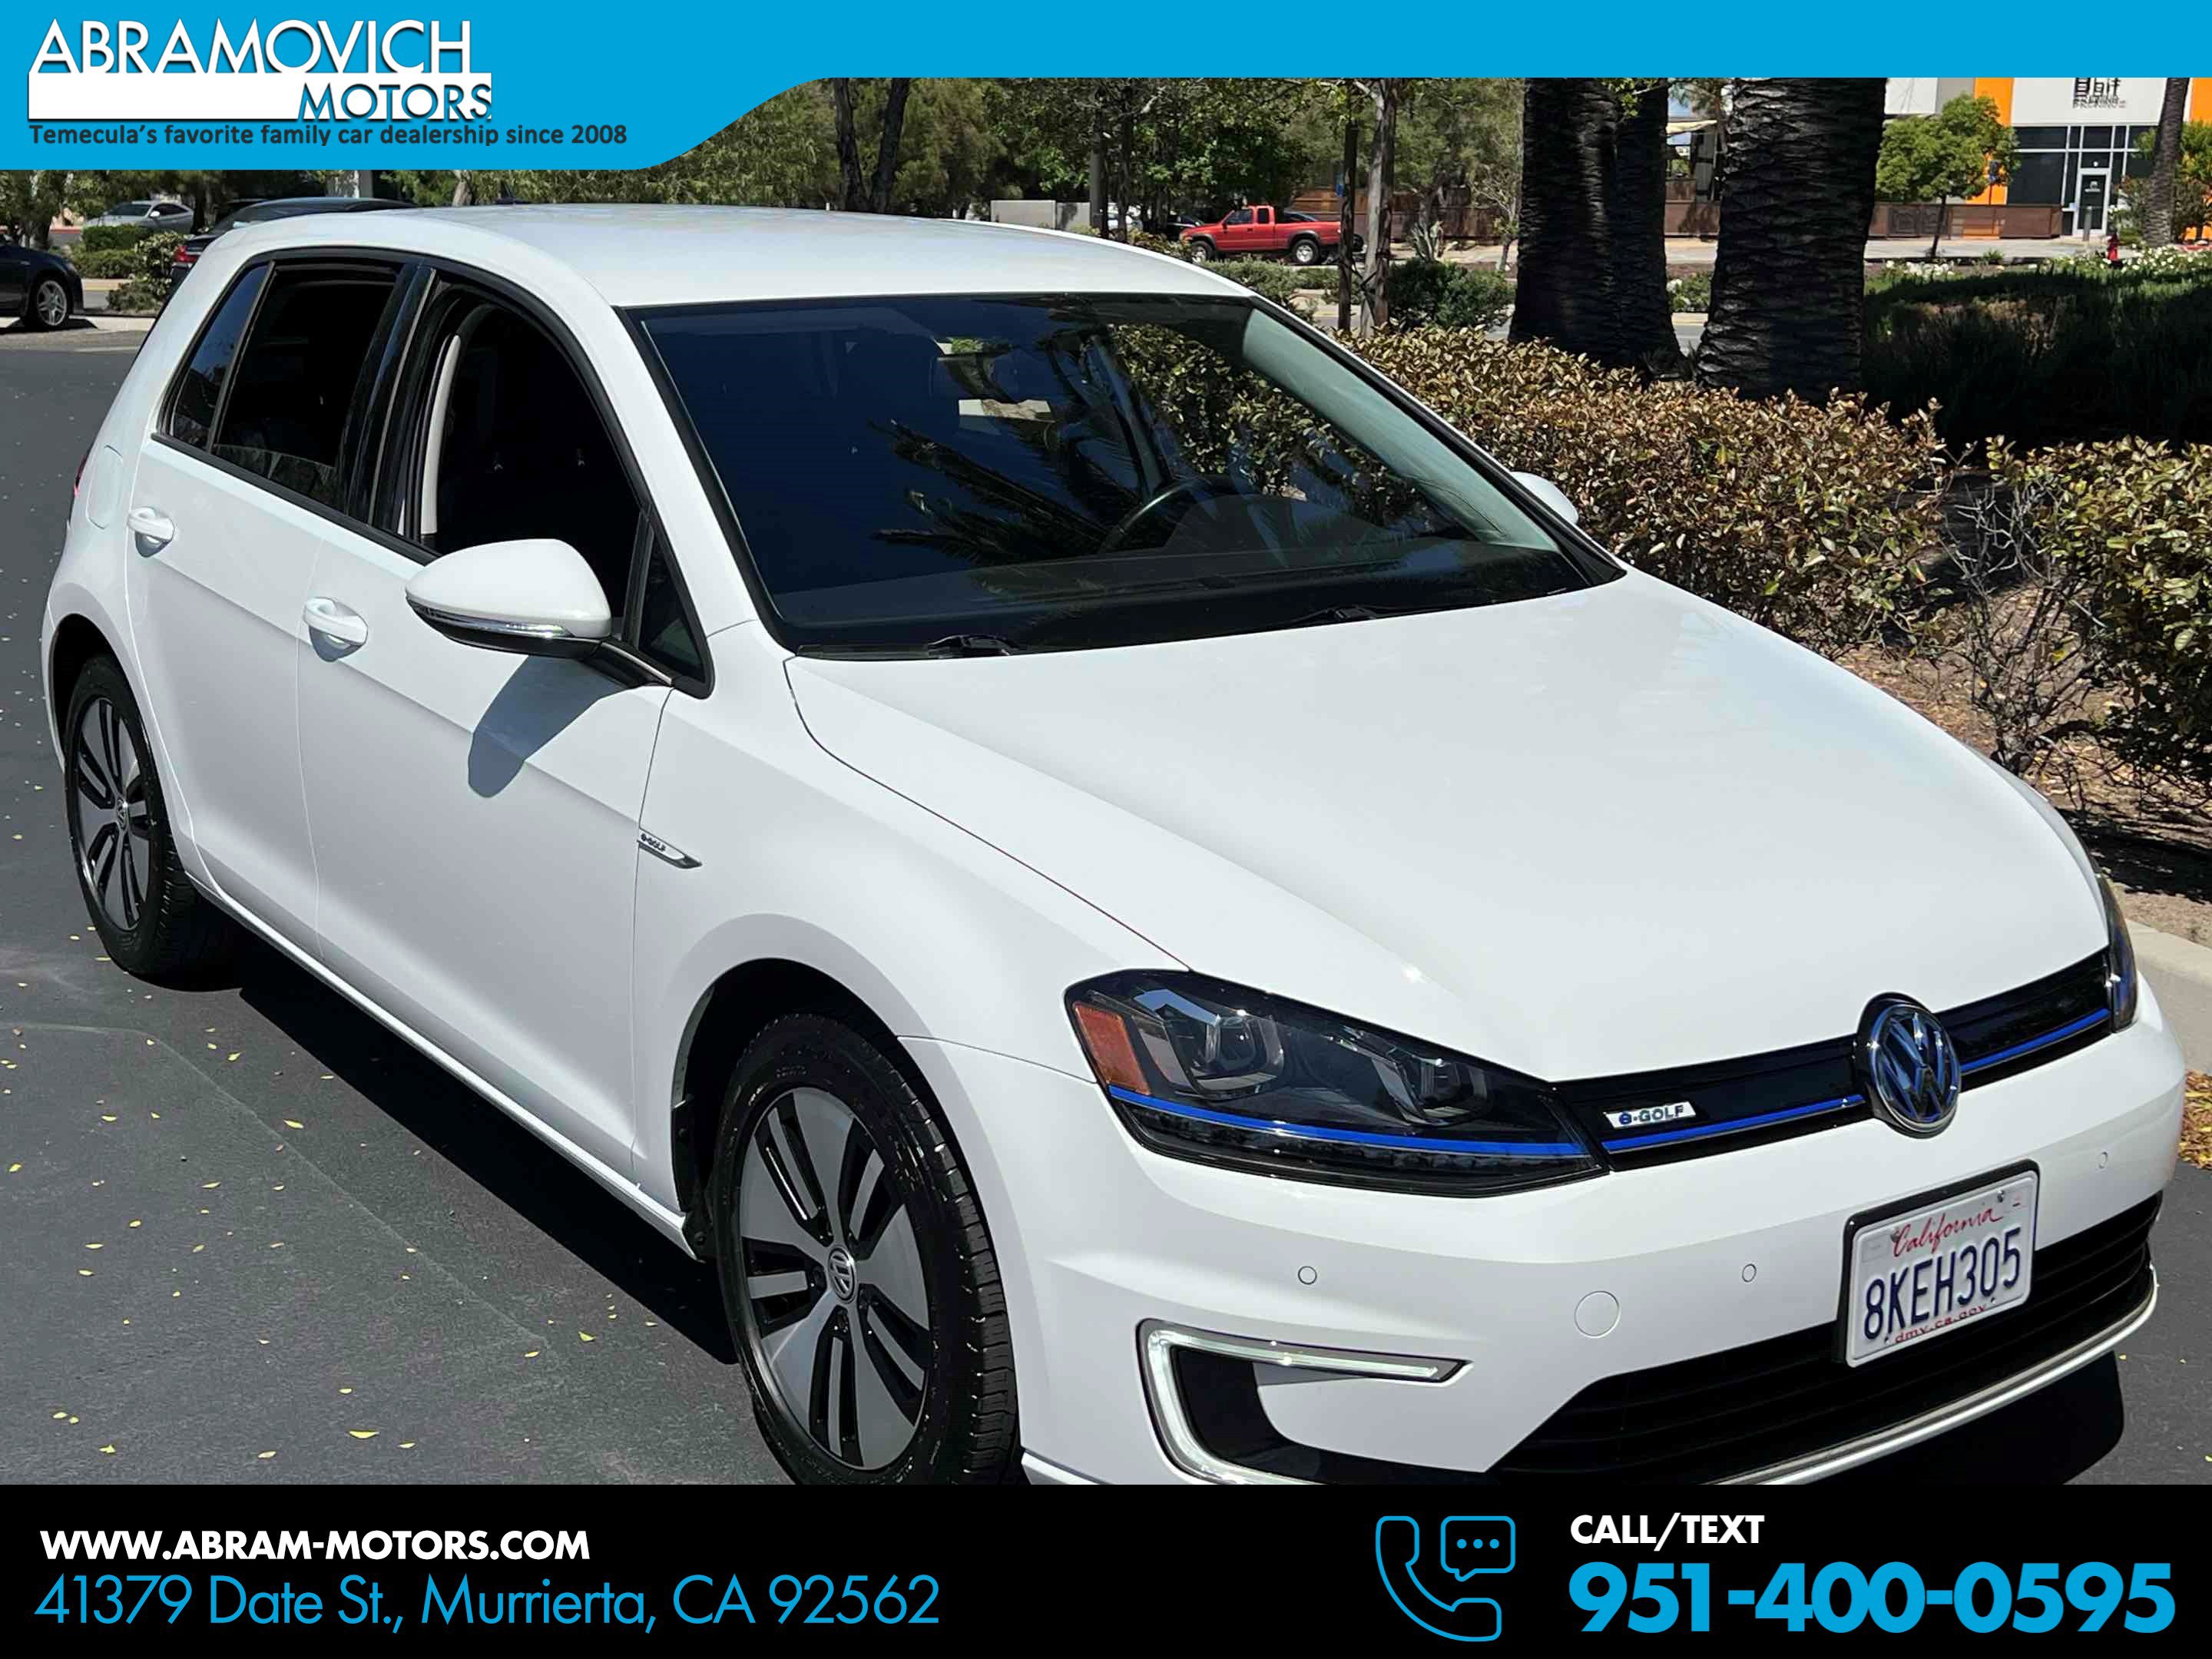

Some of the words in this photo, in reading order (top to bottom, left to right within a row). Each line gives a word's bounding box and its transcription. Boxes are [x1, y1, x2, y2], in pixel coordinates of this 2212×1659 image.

[1618, 1104, 1684, 1124] e-GOLF
[1892, 1206, 2003, 1257] California
[1864, 1227, 2021, 1339] 8KEH305
[1895, 1304, 1987, 1343] dmv.ca.gov
